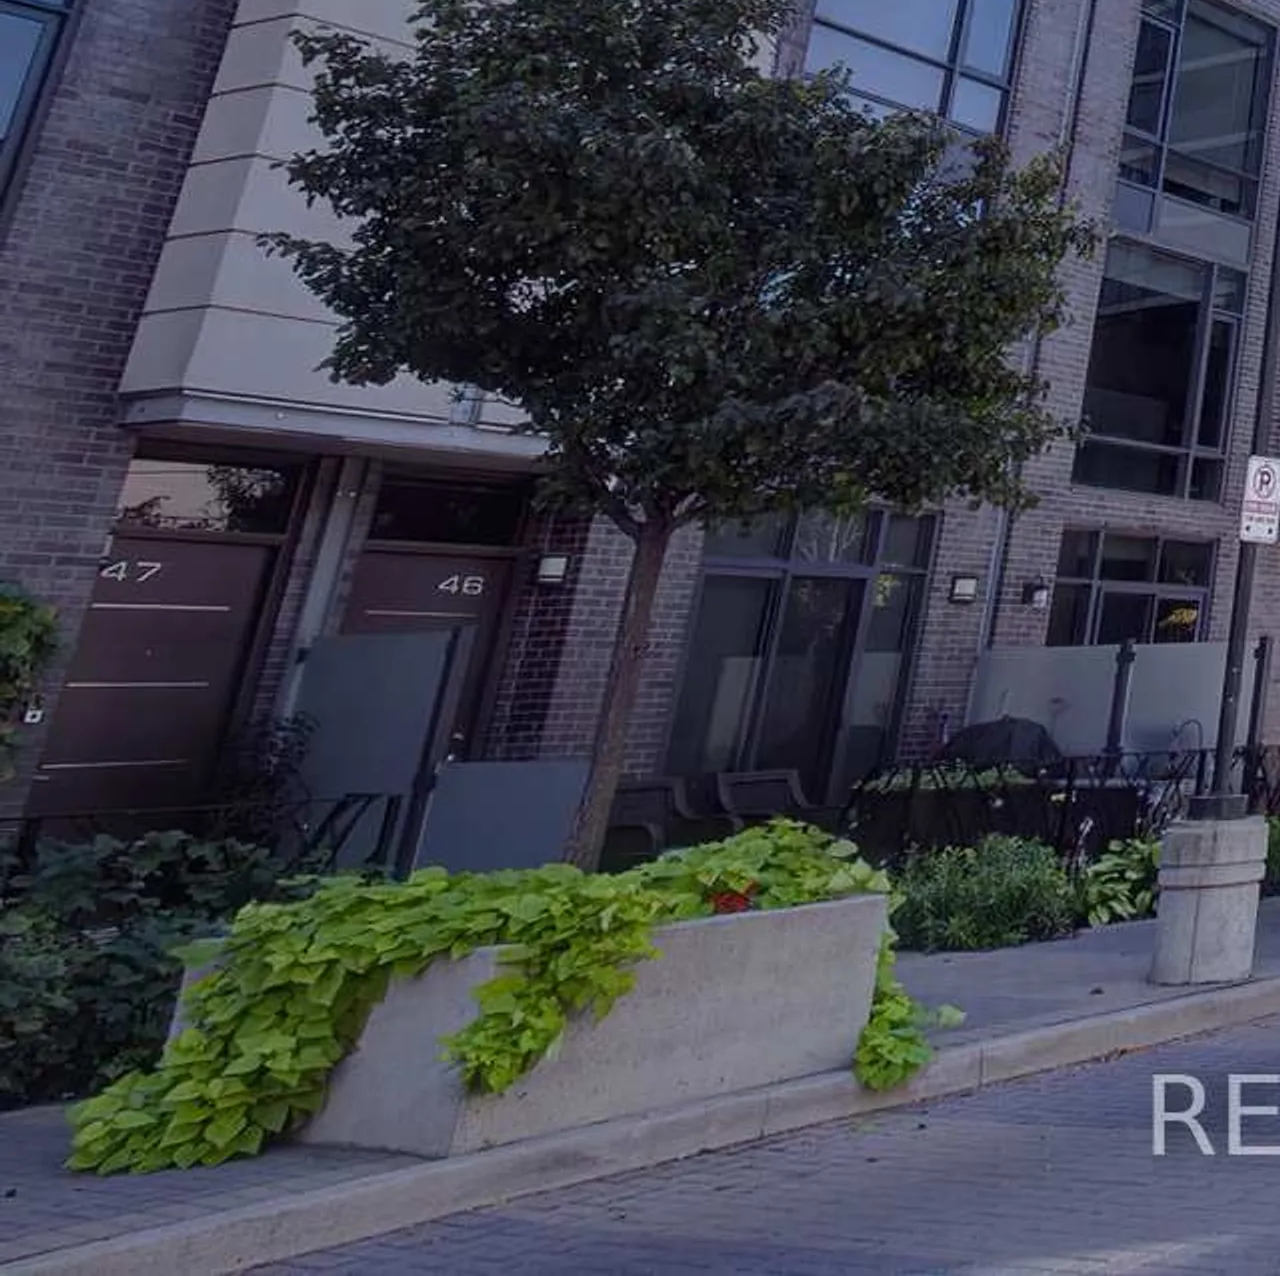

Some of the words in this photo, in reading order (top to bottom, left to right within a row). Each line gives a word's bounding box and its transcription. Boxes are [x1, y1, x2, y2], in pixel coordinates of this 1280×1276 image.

[1259, 470, 1272, 492] P
[100, 561, 162, 582] 47
[438, 575, 484, 596] 46
